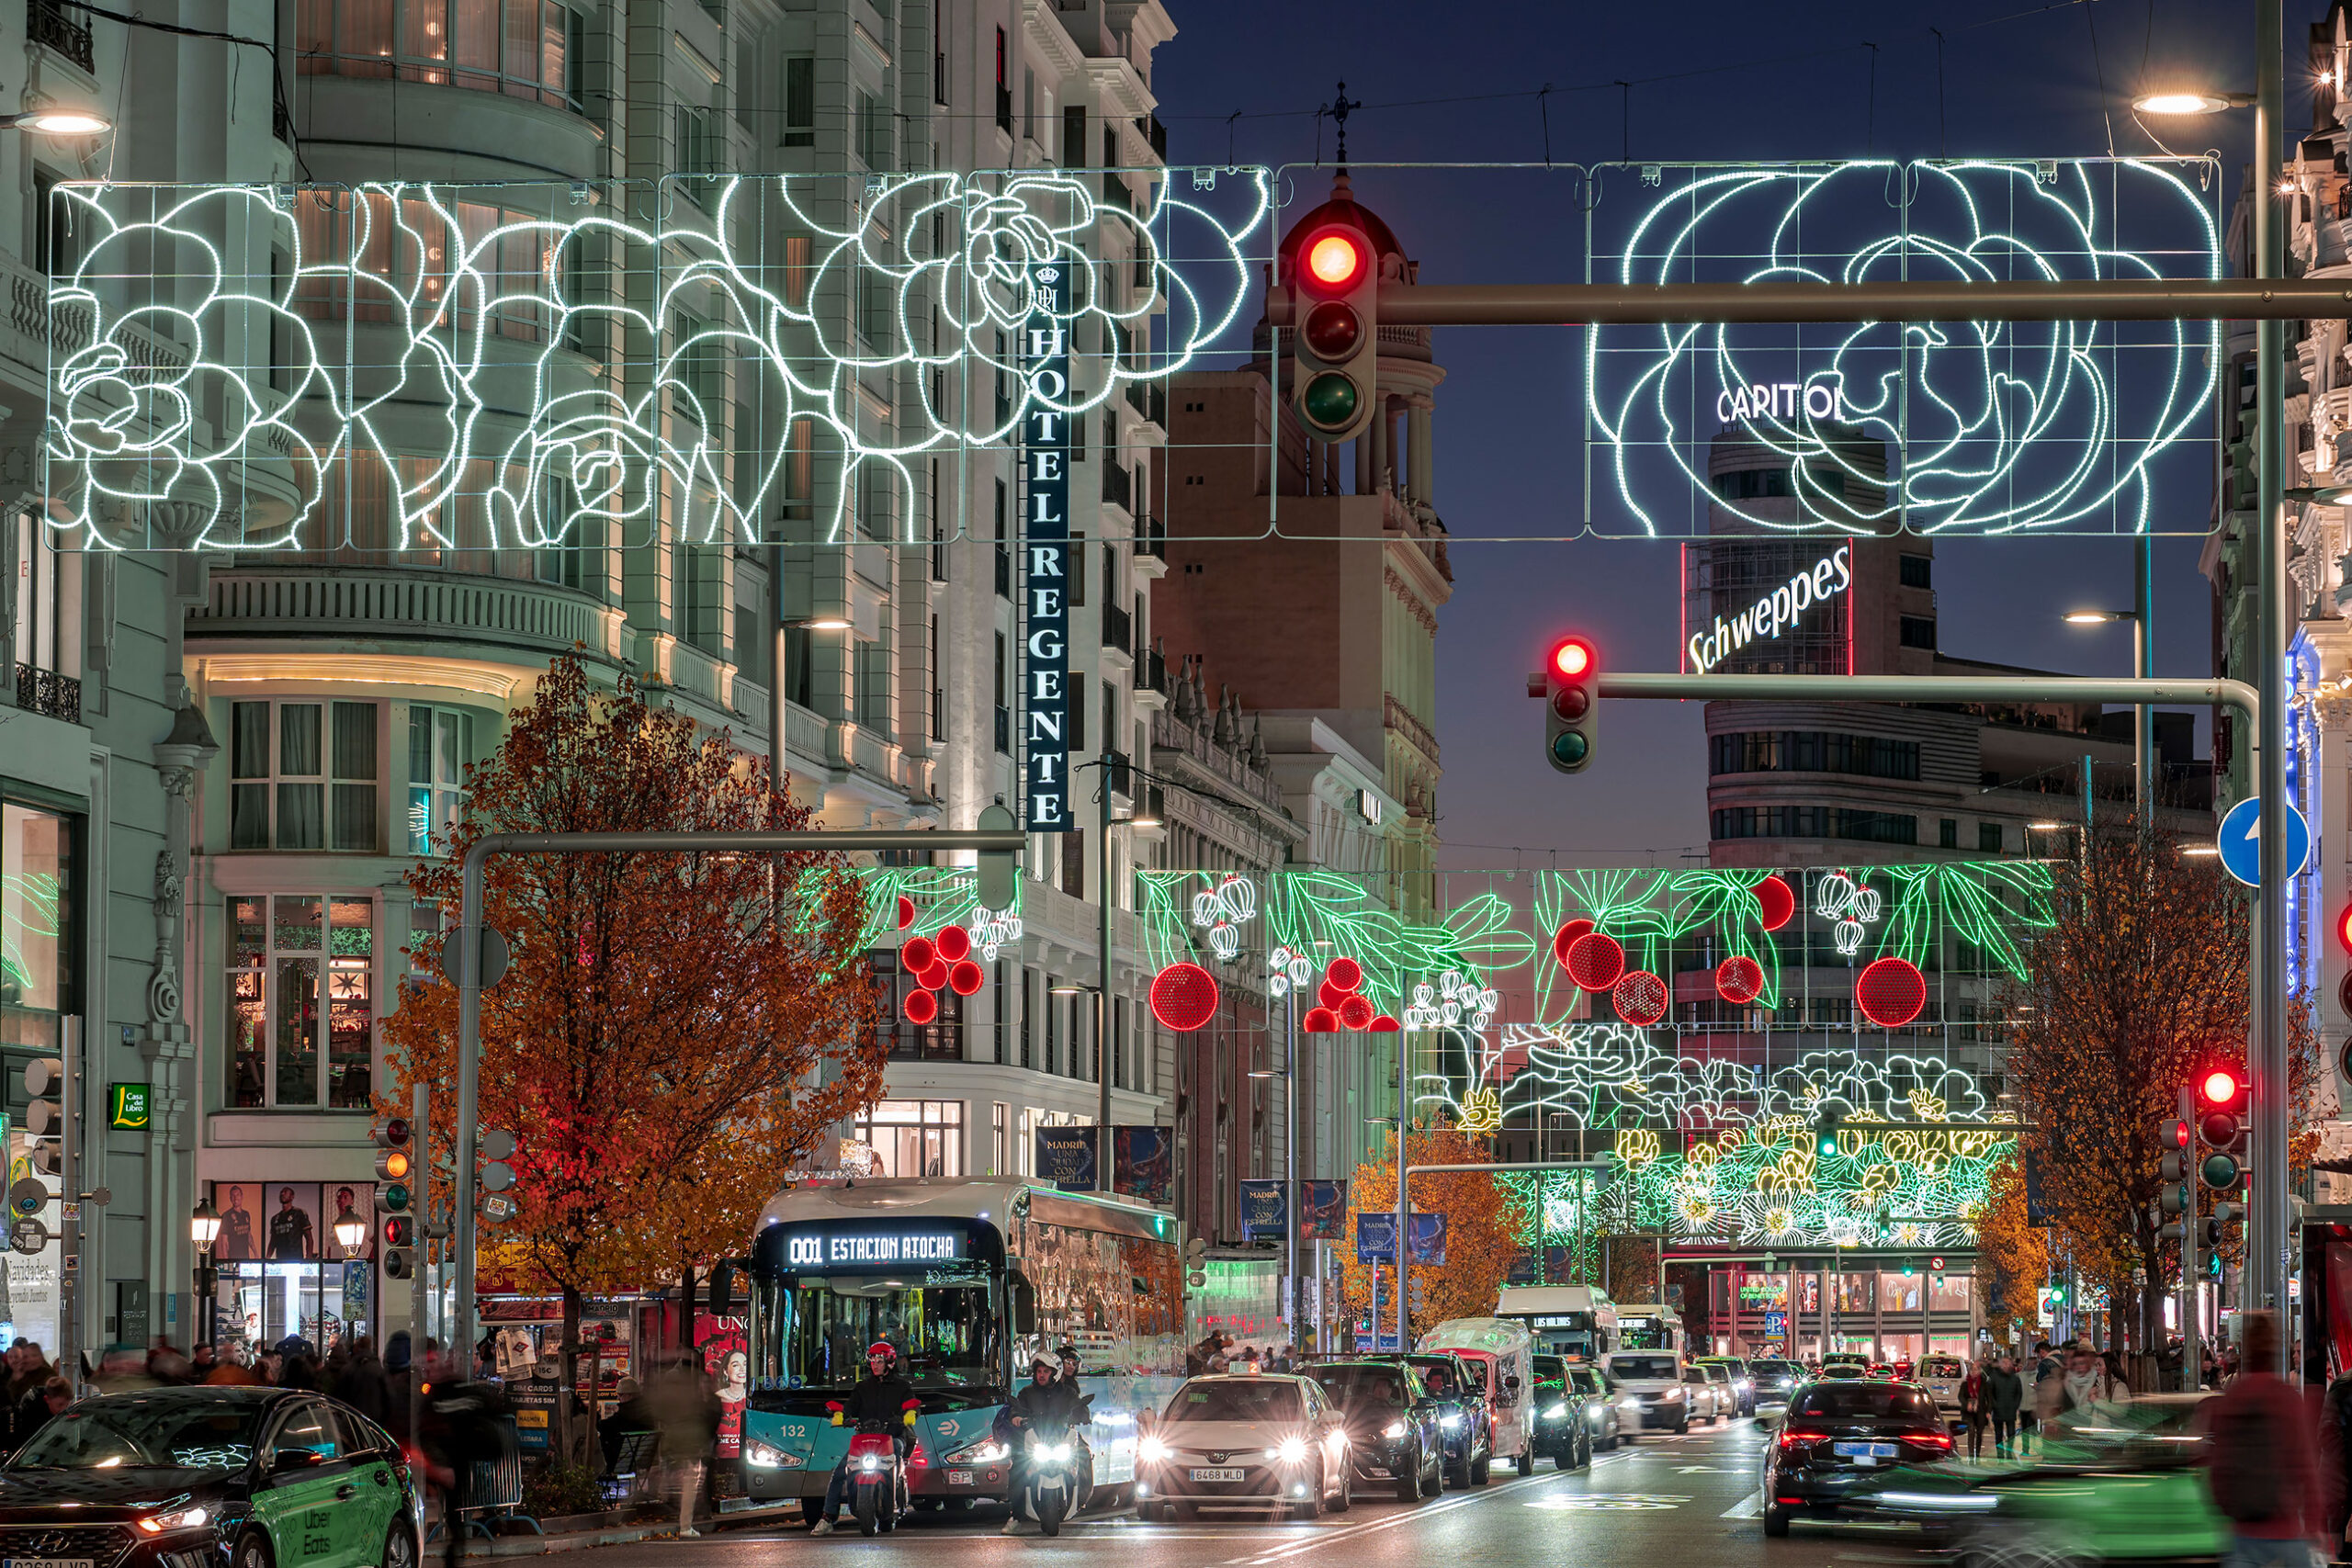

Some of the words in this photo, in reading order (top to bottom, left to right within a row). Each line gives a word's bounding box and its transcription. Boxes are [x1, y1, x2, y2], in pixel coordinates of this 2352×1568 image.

[1717, 383, 1846, 423] CAPITOL
[1028, 329, 1067, 523] HOTEL
[1689, 546, 1850, 675] Schweppes
[1029, 547, 1065, 823] REGENTE
[126, 1092, 143, 1100] Casa
[125, 1104, 143, 1112] Libro
[1046, 1140, 1087, 1149] MADRID
[1057, 1149, 1079, 1157] UNA
[1050, 1157, 1084, 1167] CIUDAD
[1054, 1167, 1077, 1176] CON
[790, 1237, 823, 1264] 001
[831, 1237, 899, 1260] ESTACION
[902, 1236, 954, 1258] ATOCHA
[588, 1304, 618, 1313] MADRID
[1770, 1316, 1781, 1333] P
[1250, 1362, 1258, 1373] 2
[780, 1425, 806, 1438] 132
[951, 1472, 970, 1483] SP
[1195, 1471, 1221, 1480] 6468
[1223, 1471, 1242, 1480] MLD
[304, 1508, 332, 1529] Uber
[303, 1533, 332, 1555] Eats
